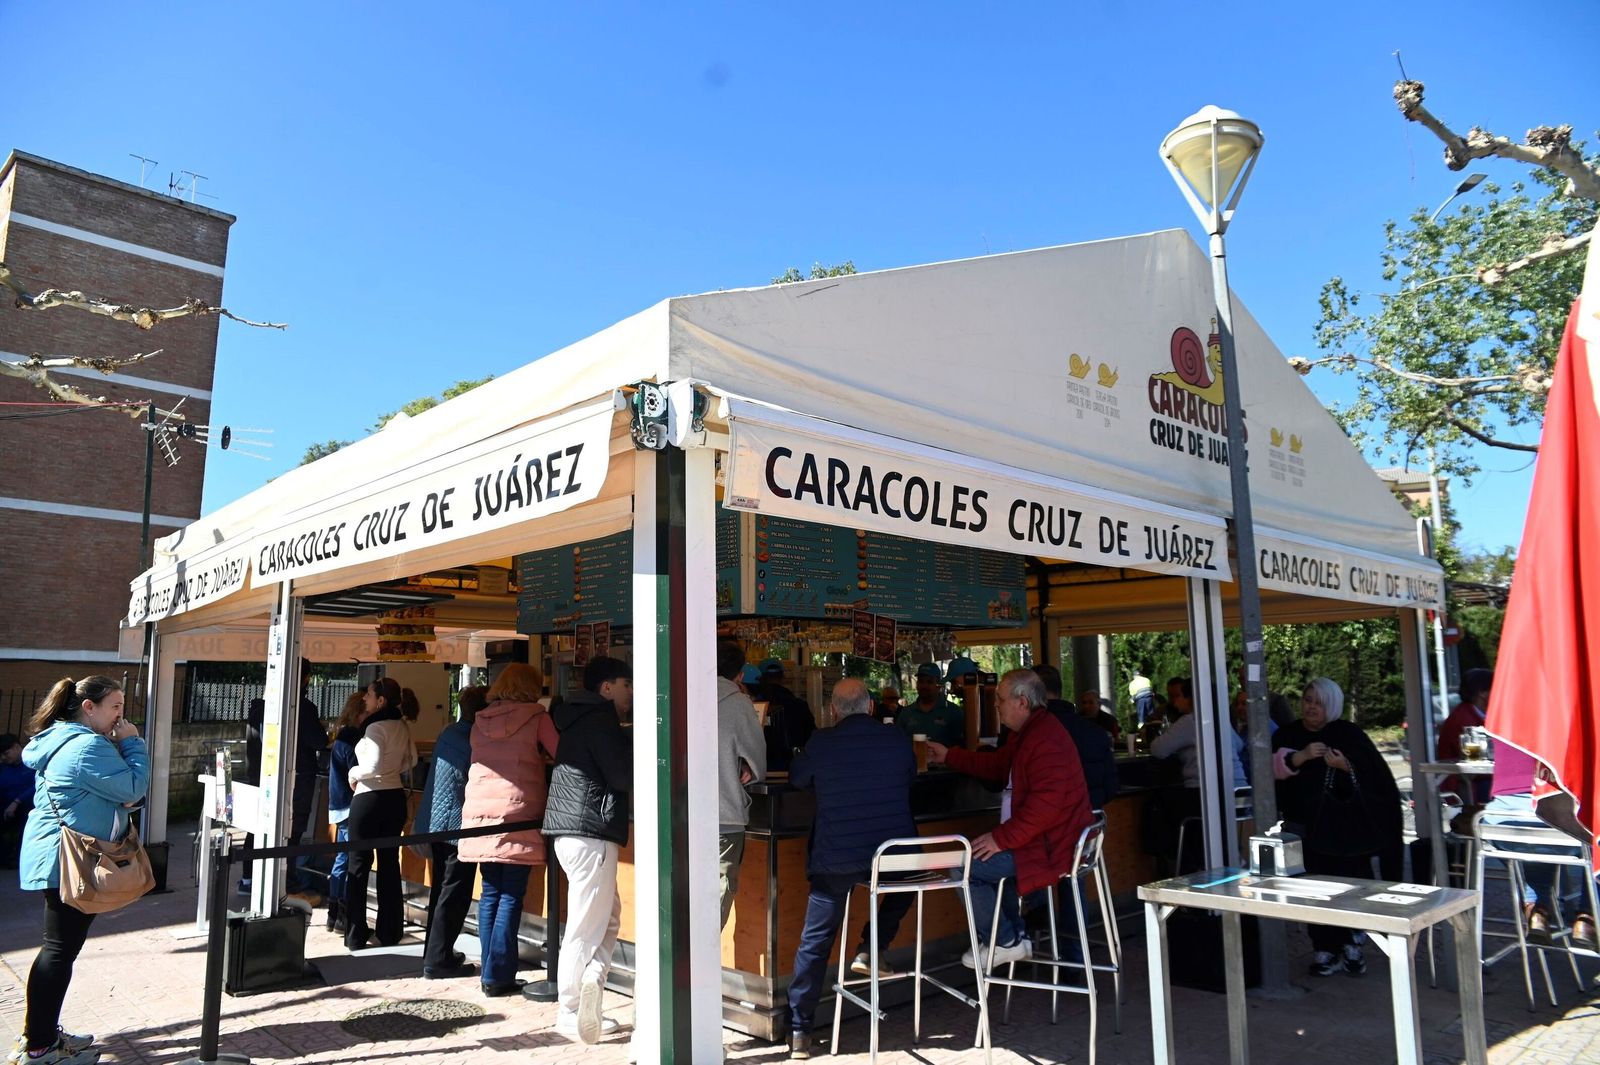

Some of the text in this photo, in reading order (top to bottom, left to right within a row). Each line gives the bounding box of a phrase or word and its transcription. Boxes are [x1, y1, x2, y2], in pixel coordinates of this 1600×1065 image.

[1149, 418, 1184, 453] CRUZ
[1187, 429, 1205, 459] DE
[258, 442, 585, 576] CARACOLES CRUZ DE JUÁREZ
[765, 446, 1218, 571] CARACOLES CRUZ DE JUÁREZ
[195, 571, 209, 600] DE
[1259, 548, 1341, 591] CARACOLES
[1349, 566, 1380, 596] CRUZ
[1386, 573, 1401, 599] DE
